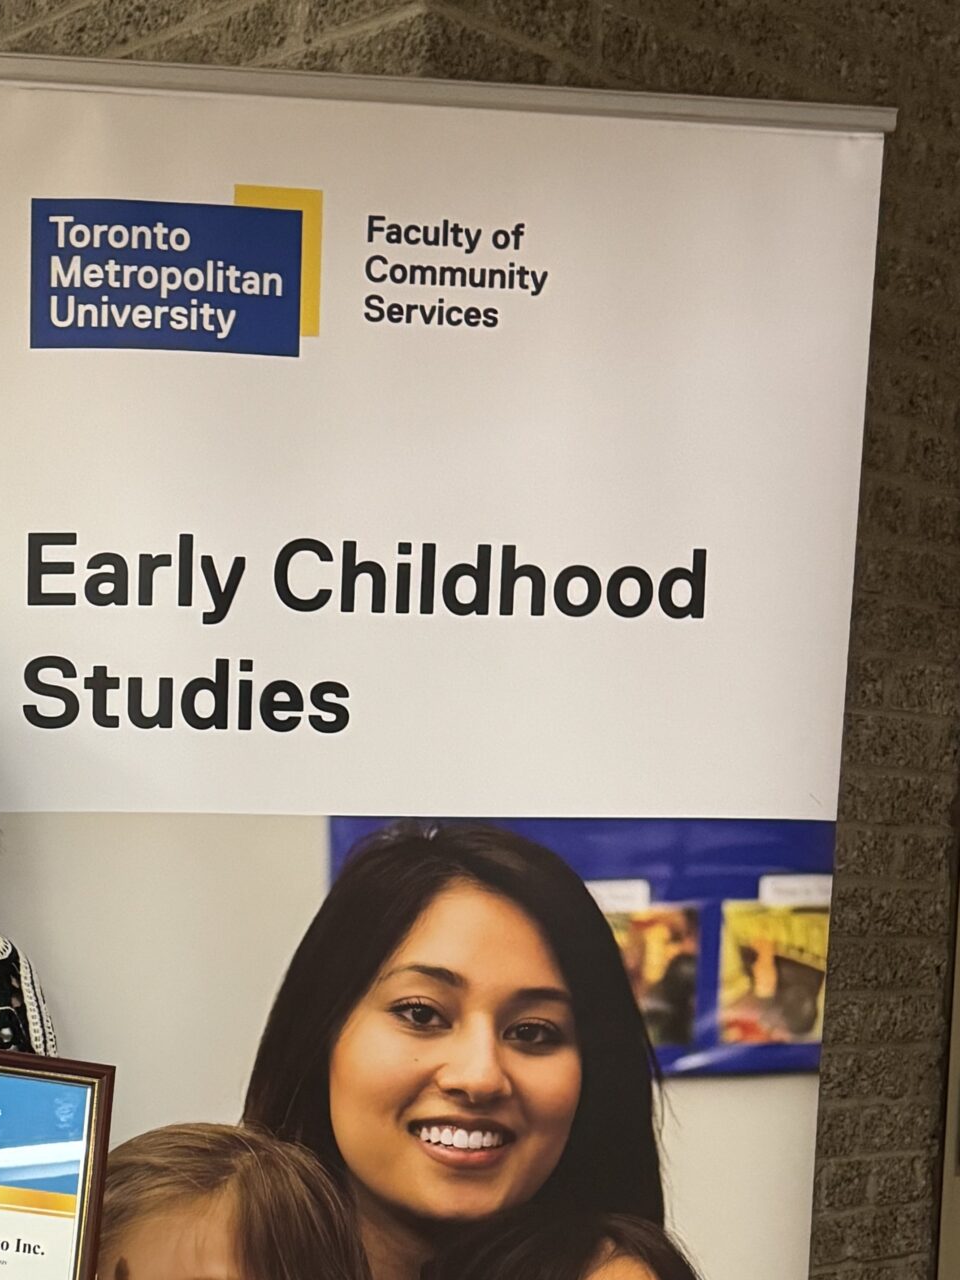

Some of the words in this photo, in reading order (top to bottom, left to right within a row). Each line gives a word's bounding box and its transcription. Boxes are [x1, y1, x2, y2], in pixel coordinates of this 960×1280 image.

[48, 215, 191, 252] Toronto
[367, 214, 482, 255] Faculty
[491, 222, 526, 251] of
[50, 255, 283, 299] Metropolitan
[365, 254, 549, 297] Community
[50, 295, 236, 339] University
[363, 294, 499, 328] Services
[27, 532, 246, 625] Early
[273, 537, 707, 620] Childhood
[22, 655, 350, 734] Studies
[14, 1238, 45, 1256] Inc.
